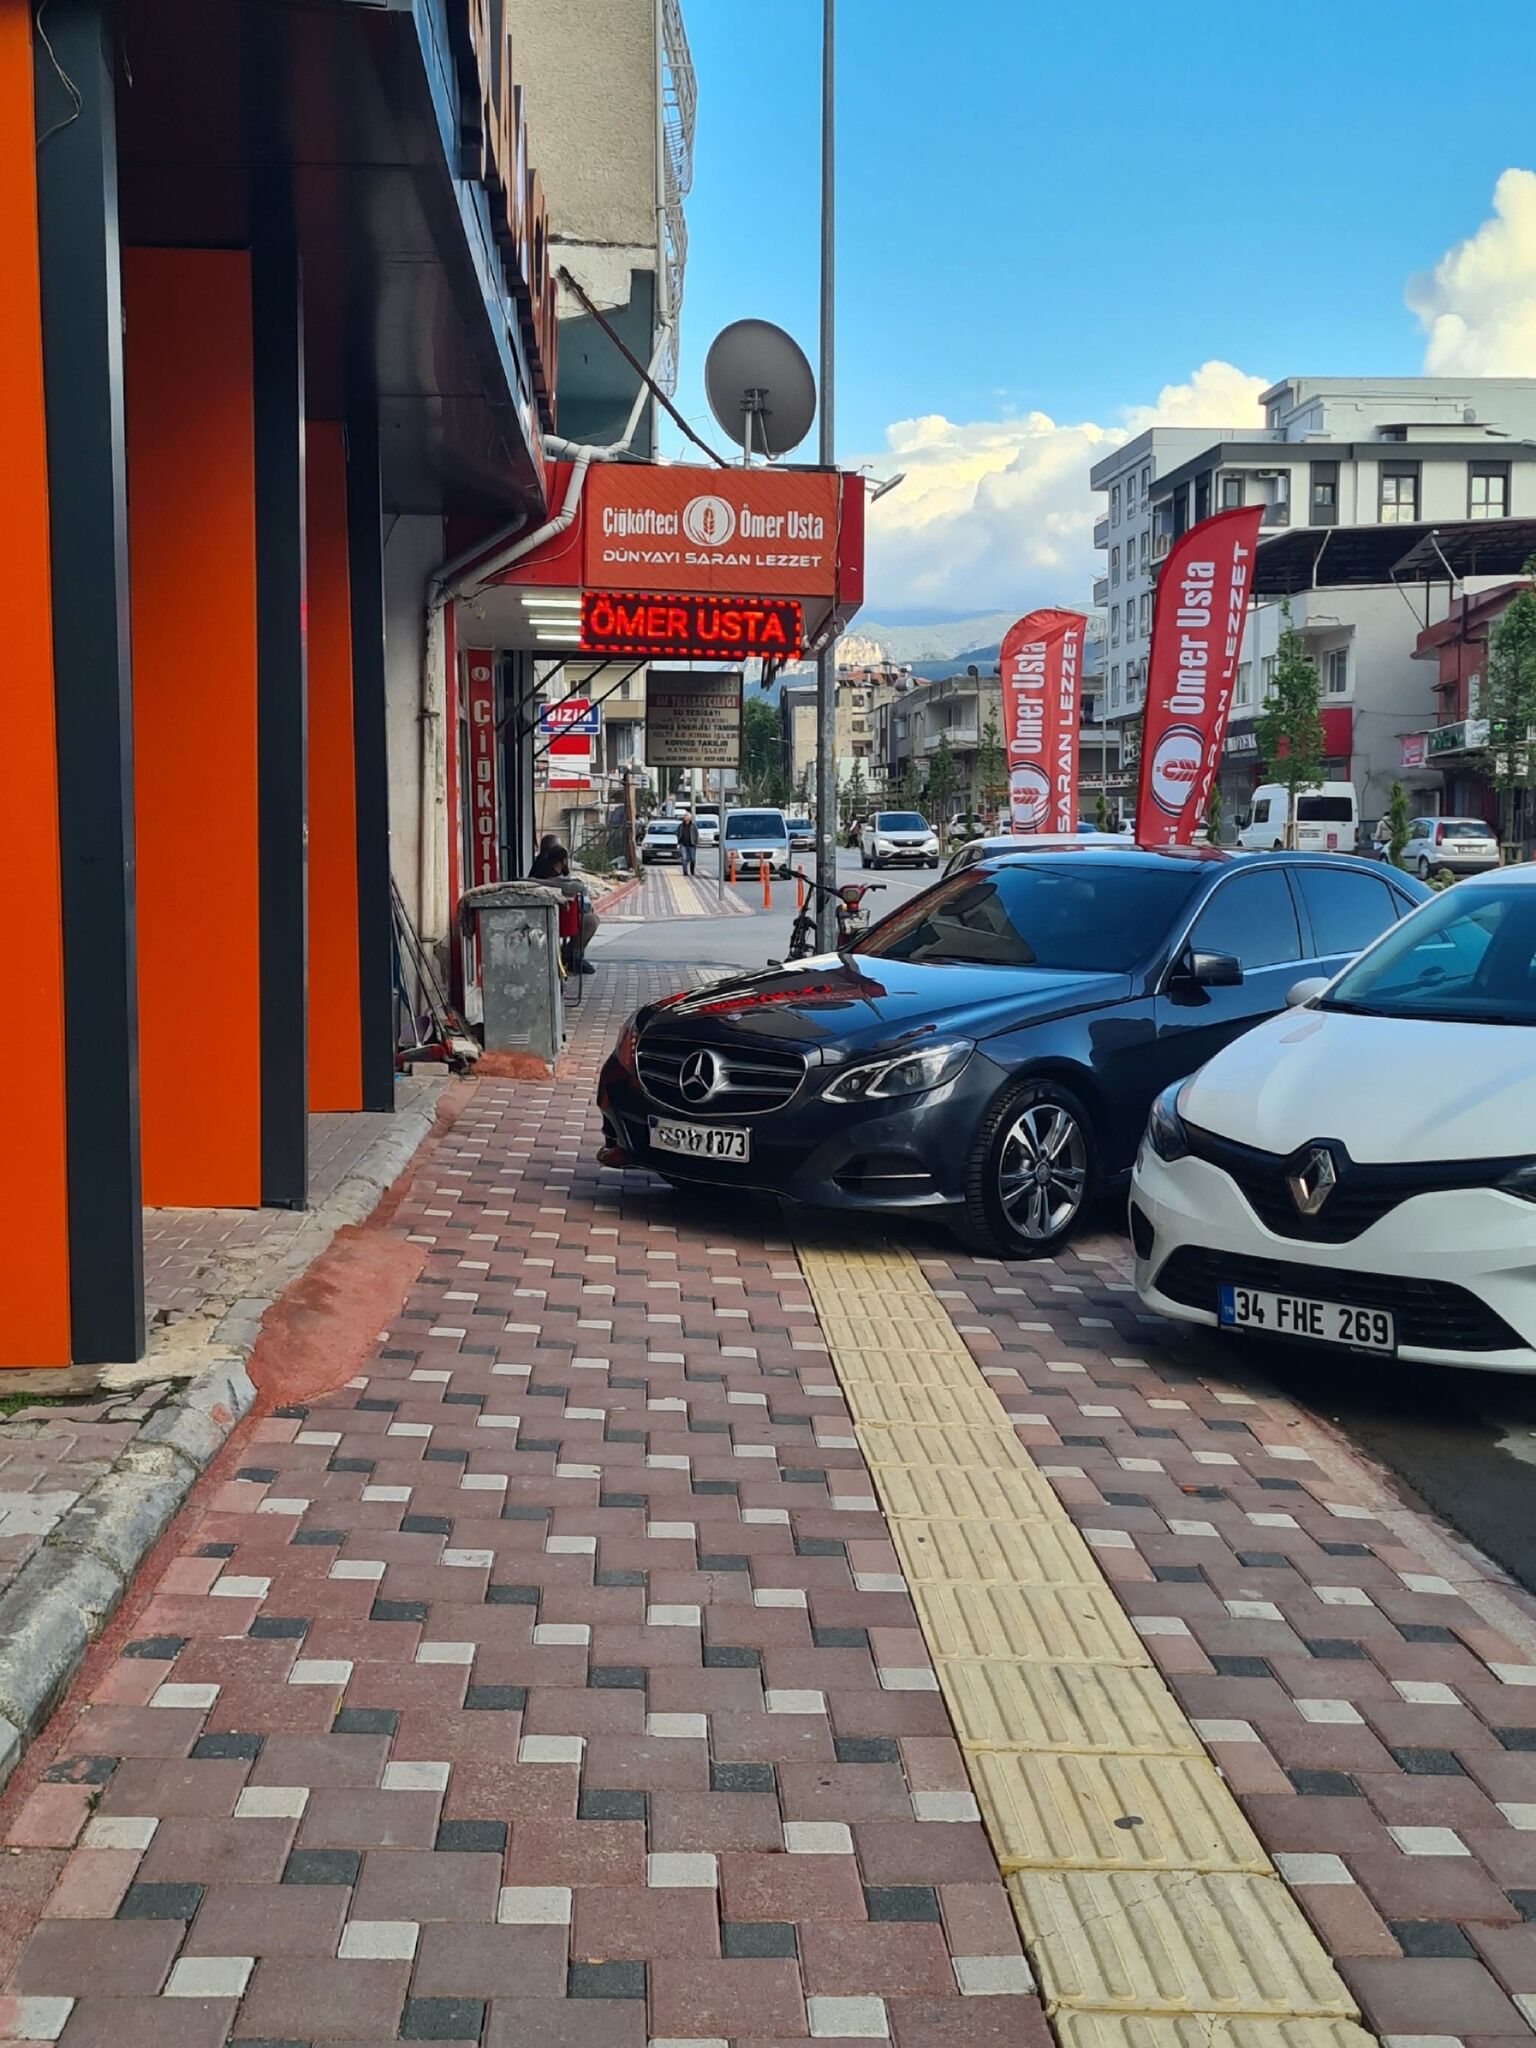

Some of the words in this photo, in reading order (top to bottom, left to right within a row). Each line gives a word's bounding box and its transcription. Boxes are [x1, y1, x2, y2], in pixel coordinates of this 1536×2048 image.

[603, 507, 679, 538] Çiğköfteci
[740, 504, 784, 539] Ömer
[787, 511, 824, 541] Usta
[603, 547, 680, 564] DÜNYAYI
[685, 552, 751, 566] SARAN
[756, 555, 822, 568] LEZZET
[591, 600, 689, 639] ÖMER
[697, 609, 786, 644] USTA
[1176, 561, 1215, 629] Usta
[1223, 541, 1248, 678] LEZZET
[1012, 641, 1047, 689] Usta
[1059, 629, 1078, 726] LEZZET
[1162, 634, 1208, 715] Ömer
[474, 699, 493, 884] Çiğköft
[1057, 734, 1072, 833] SARAN
[1236, 1291, 1265, 1324] 34
[1277, 1297, 1324, 1336] FHE
[1339, 1308, 1388, 1345] 269
